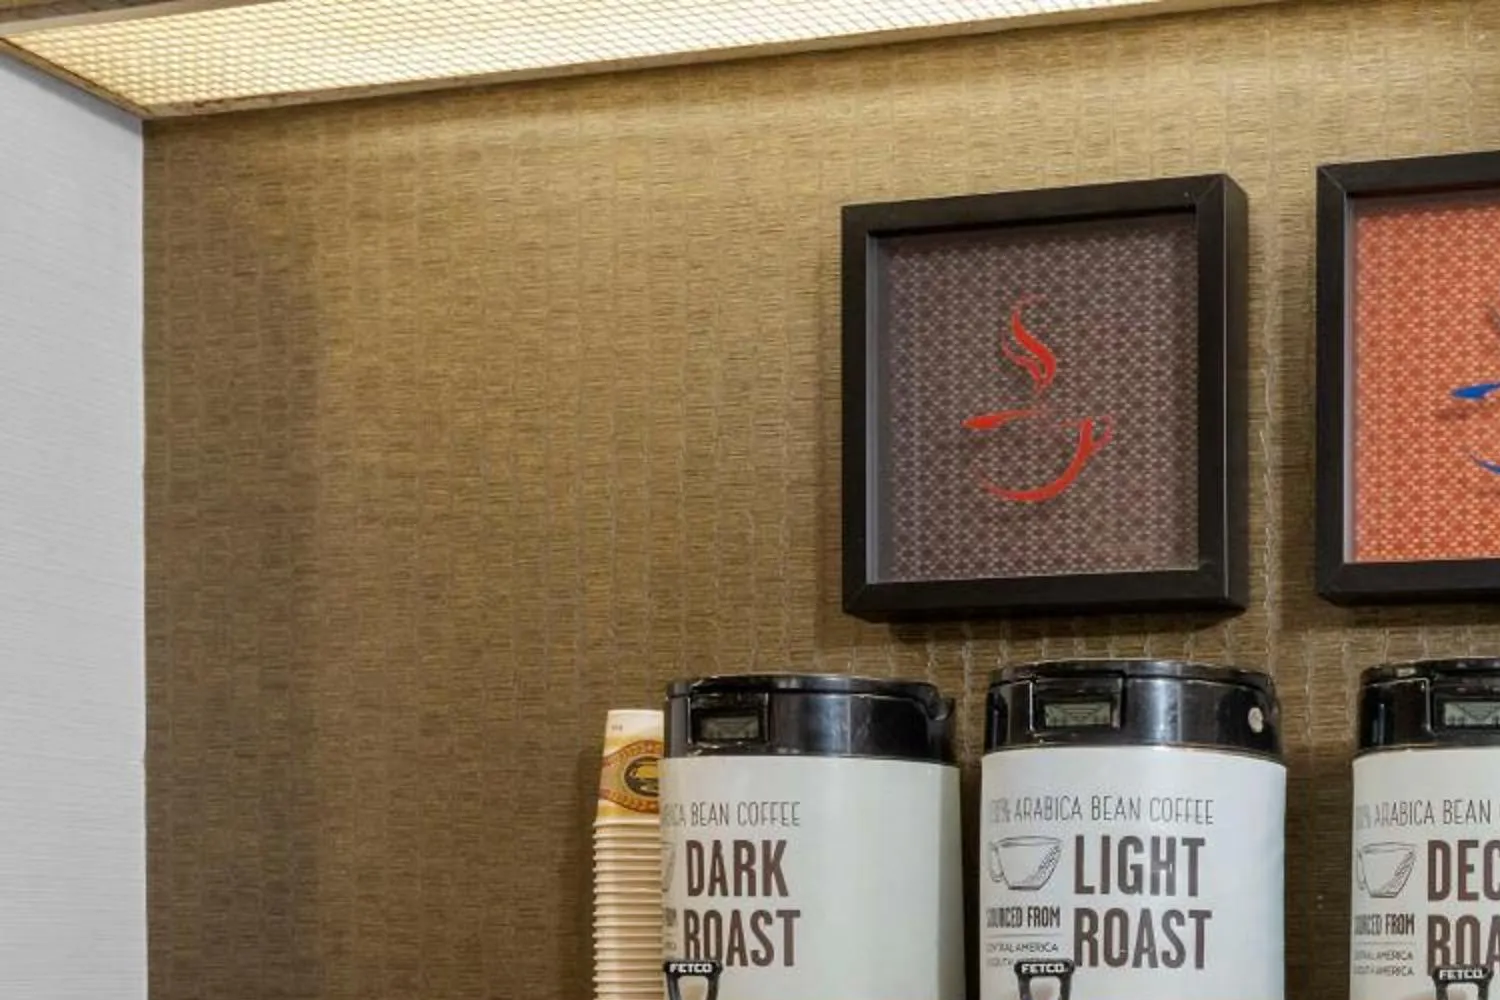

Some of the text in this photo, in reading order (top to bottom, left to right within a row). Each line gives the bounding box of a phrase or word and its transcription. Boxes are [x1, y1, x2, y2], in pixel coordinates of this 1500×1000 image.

[691, 801, 730, 827] BEAN
[737, 801, 801, 827] COFFEE
[1014, 795, 1083, 823] ARABICA
[1091, 795, 1142, 822] BEAN
[1149, 798, 1215, 825] COFFEE
[1373, 800, 1435, 828] ARABICA
[1443, 799, 1491, 825] BEAN
[686, 839, 789, 897] DARK
[1073, 834, 1206, 897] LIGHT
[1027, 905, 1061, 928] FROM
[1385, 913, 1415, 936] FROM
[683, 909, 801, 968] ROAST
[1073, 907, 1213, 970] ROAST
[669, 963, 713, 973] FETCO
[1021, 963, 1065, 974] FETCO
[1439, 969, 1484, 980] FETCO
